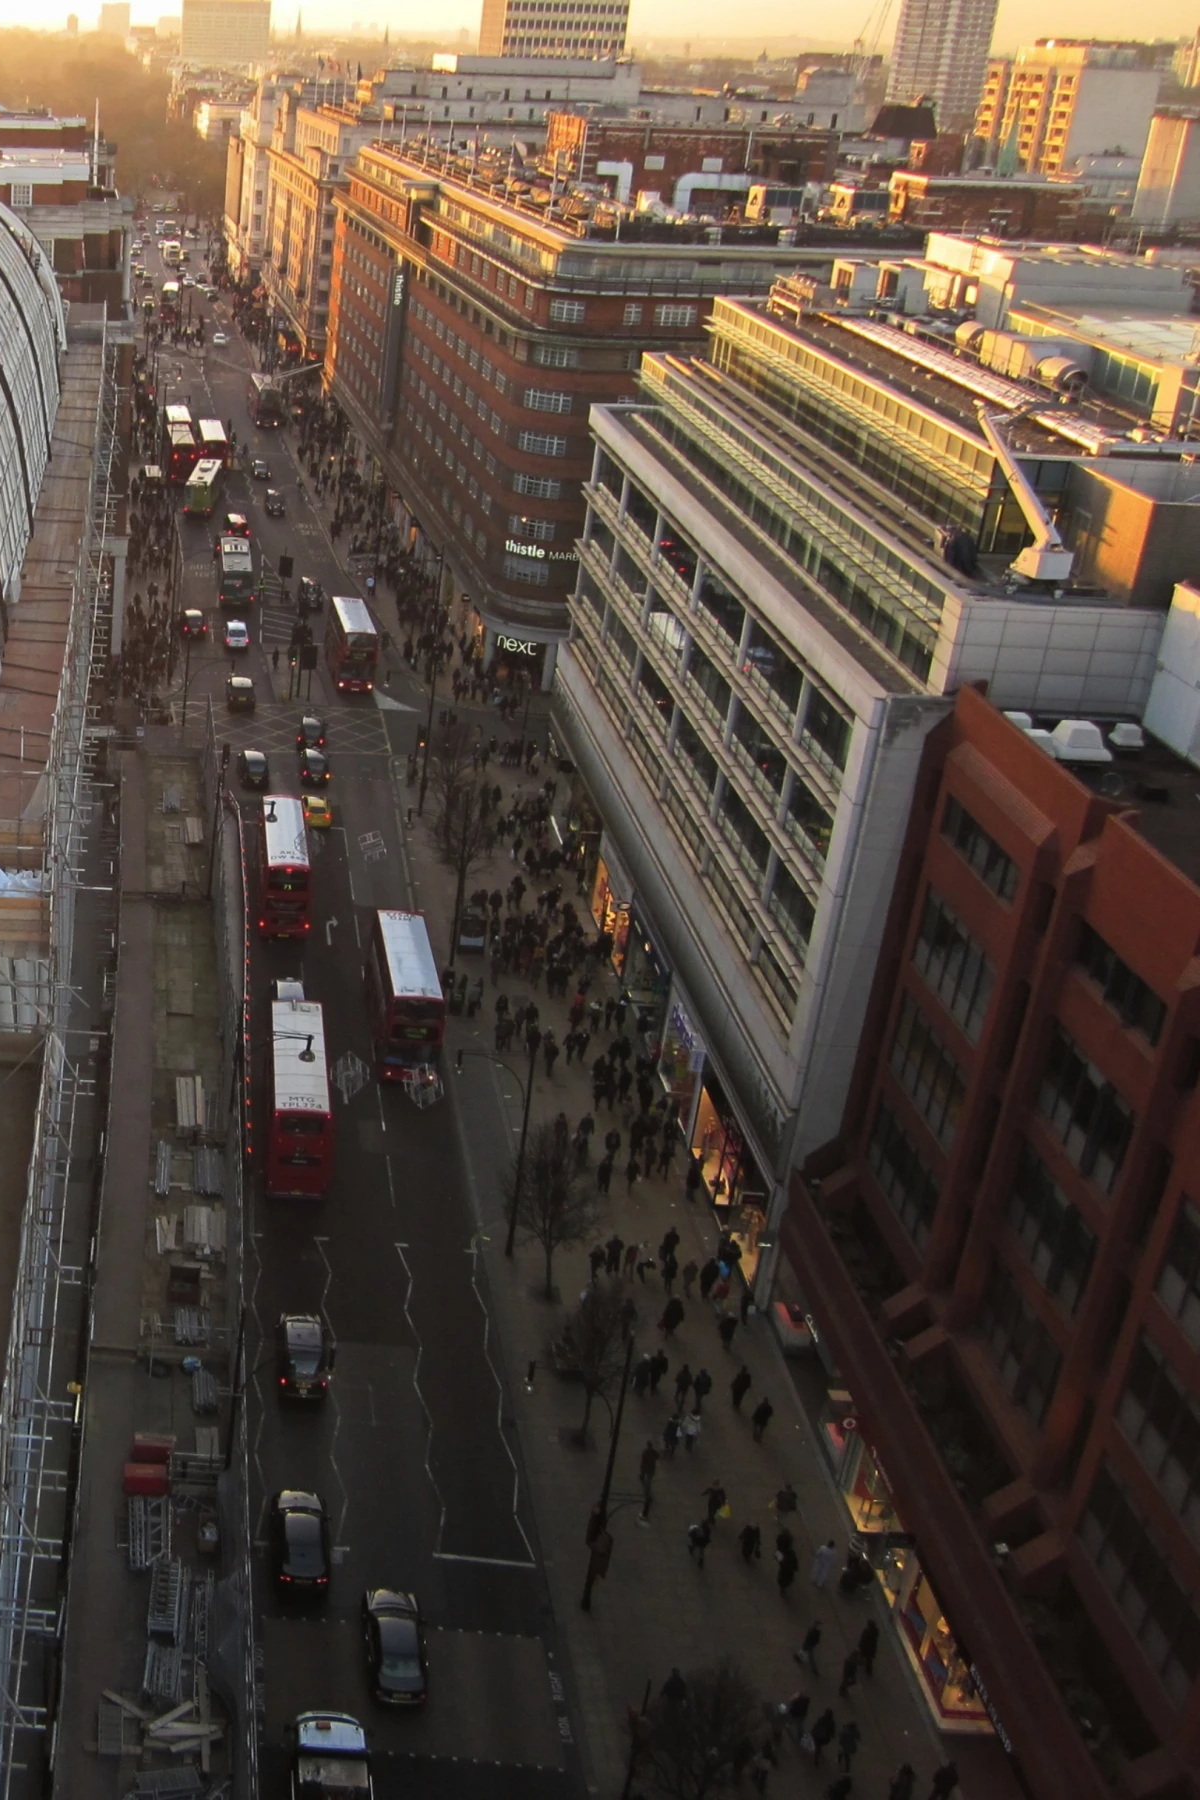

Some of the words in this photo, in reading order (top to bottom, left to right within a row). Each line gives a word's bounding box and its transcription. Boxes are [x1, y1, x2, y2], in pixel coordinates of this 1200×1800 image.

[393, 274, 404, 306] thistle
[505, 539, 546, 559] thistle
[496, 634, 537, 656] next
